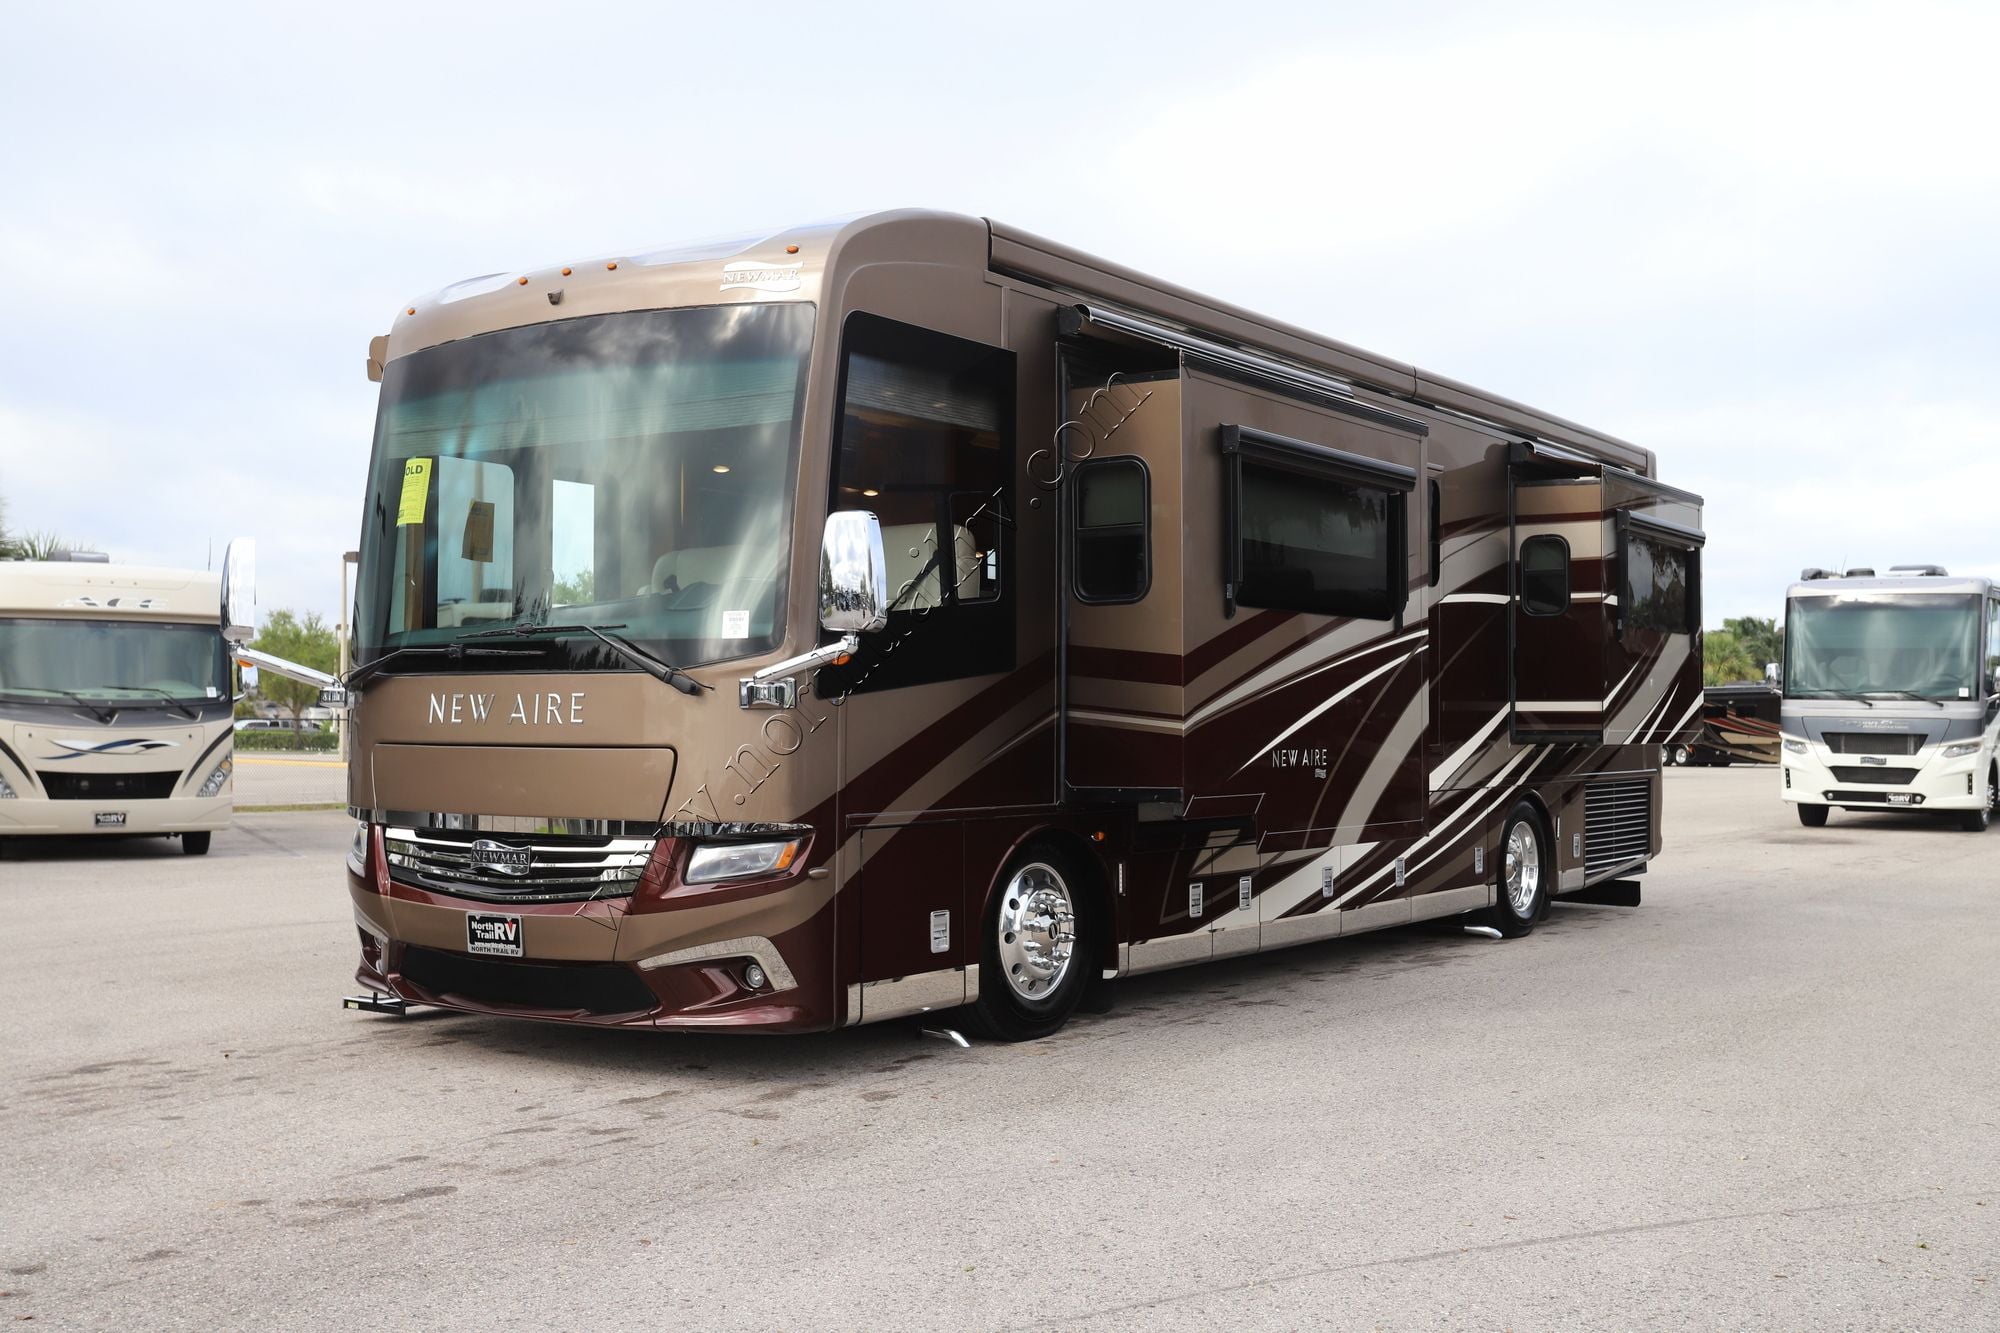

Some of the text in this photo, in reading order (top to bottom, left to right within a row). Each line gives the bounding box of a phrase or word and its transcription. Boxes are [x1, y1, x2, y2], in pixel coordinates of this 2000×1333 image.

[429, 693, 585, 725] NEW AIRE
[1272, 748, 1327, 768] NEW AIRE
[472, 851, 528, 865] NEWMAR
[471, 921, 493, 931] North
[494, 922, 517, 941] RV
[476, 930, 494, 940] Trail
